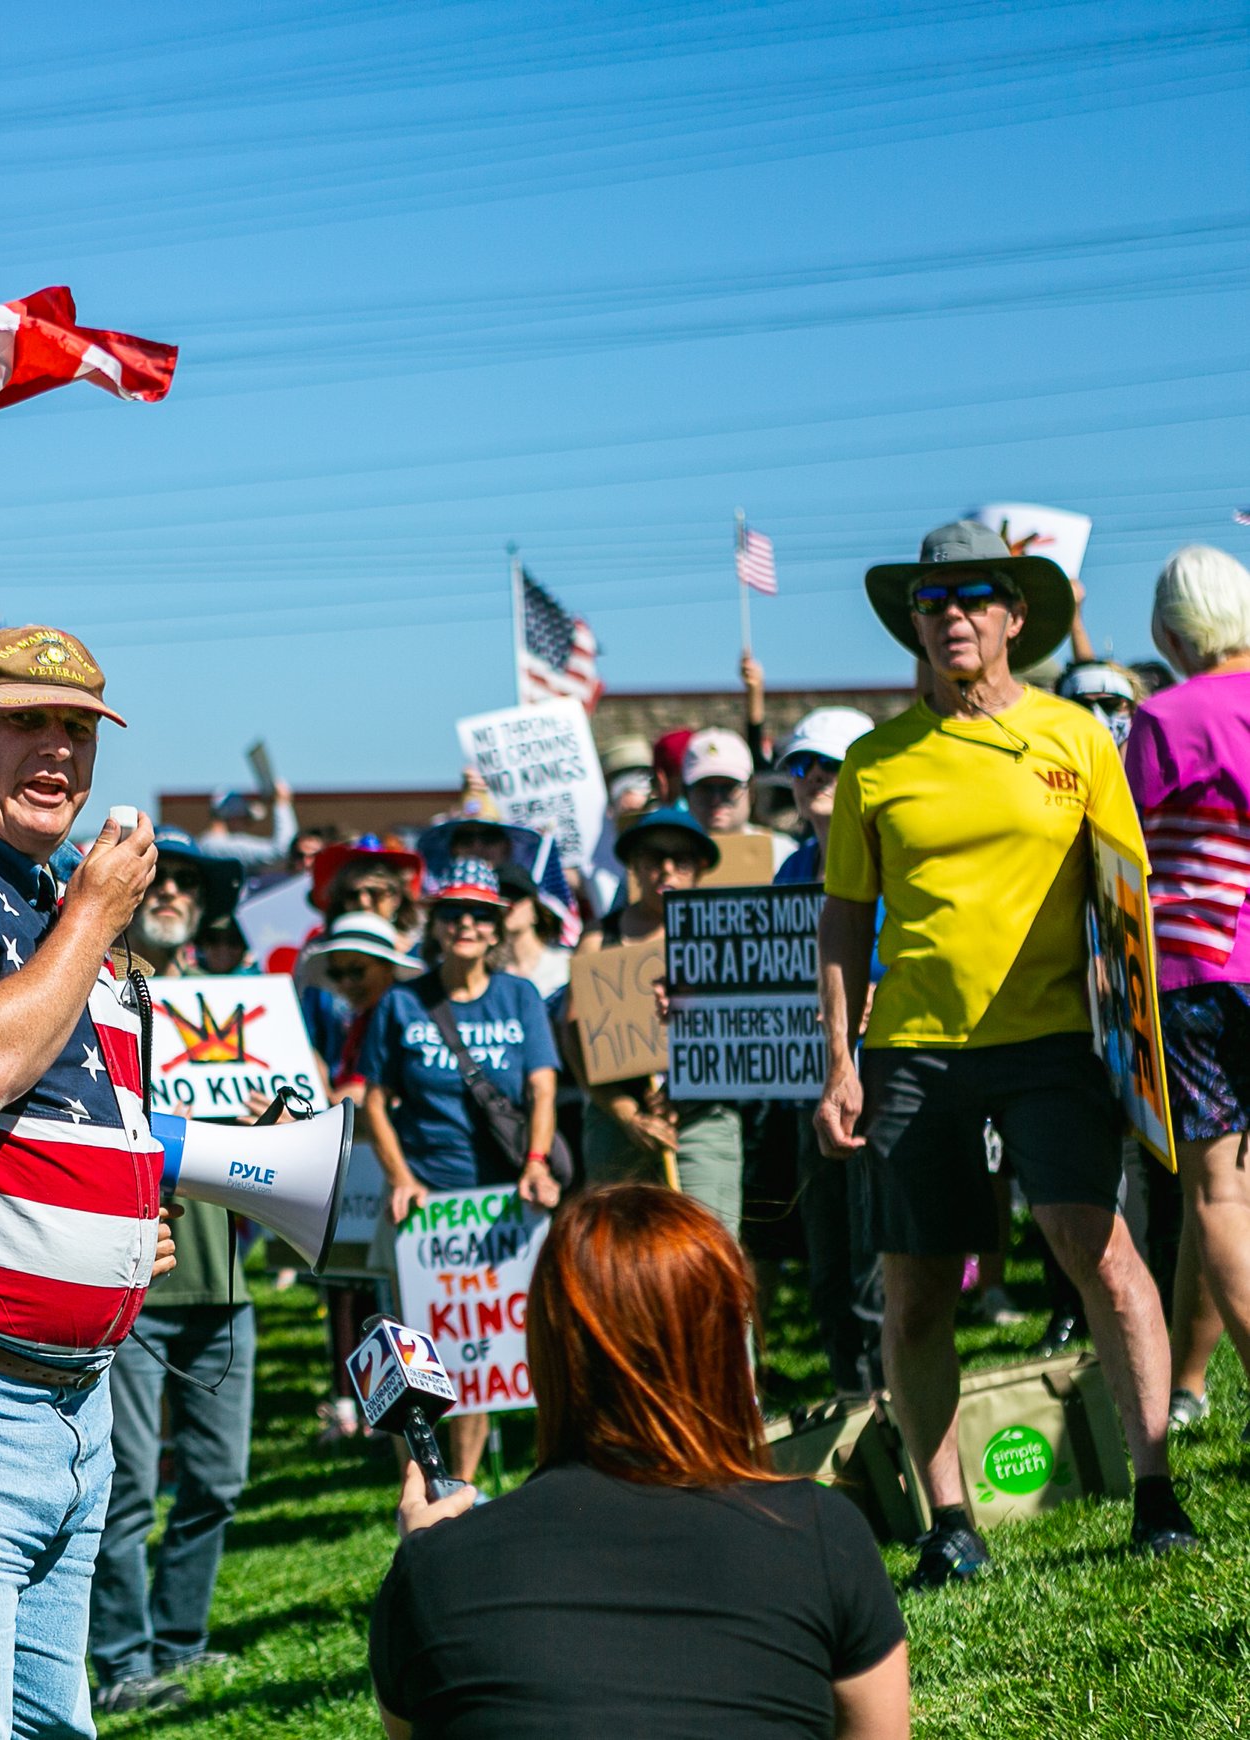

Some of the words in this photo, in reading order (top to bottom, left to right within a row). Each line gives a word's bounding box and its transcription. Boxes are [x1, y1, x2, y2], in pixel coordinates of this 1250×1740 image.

[17, 631, 67, 649] MARINE
[28, 666, 86, 684] VETERAN
[519, 755, 587, 793] KINGS
[667, 901, 687, 938] IF
[690, 897, 770, 937] THERE'S
[773, 894, 827, 934] MON
[670, 940, 717, 985] FOR
[721, 941, 739, 984] A
[742, 936, 818, 984] PARAD
[405, 1018, 524, 1047] GETING
[585, 1008, 667, 1071] KIN
[672, 1008, 715, 1040] THEN
[717, 1006, 783, 1039] THERE'S
[787, 1005, 826, 1037] MON
[673, 1044, 720, 1086] FOR
[725, 1042, 827, 1086] MEDICAI
[151, 1077, 195, 1106] NO
[207, 1074, 315, 1106] KINGS
[227, 1178, 272, 1194] PyleUSA.com
[228, 1161, 275, 1185] PYLE
[437, 1267, 499, 1295] THE
[429, 1292, 527, 1343] KING
[398, 1329, 442, 1375] 2
[461, 1338, 492, 1364] OF
[359, 1338, 396, 1401] 2
[409, 1378, 430, 1390] VERY
[433, 1384, 452, 1396] OWN
[448, 1362, 532, 1411] HAO
[365, 1370, 402, 1413] COLORADO'S
[368, 1402, 388, 1421] VERY
[387, 1379, 405, 1403] OWN
[992, 1441, 1042, 1465] simple
[995, 1455, 1047, 1480] truth
